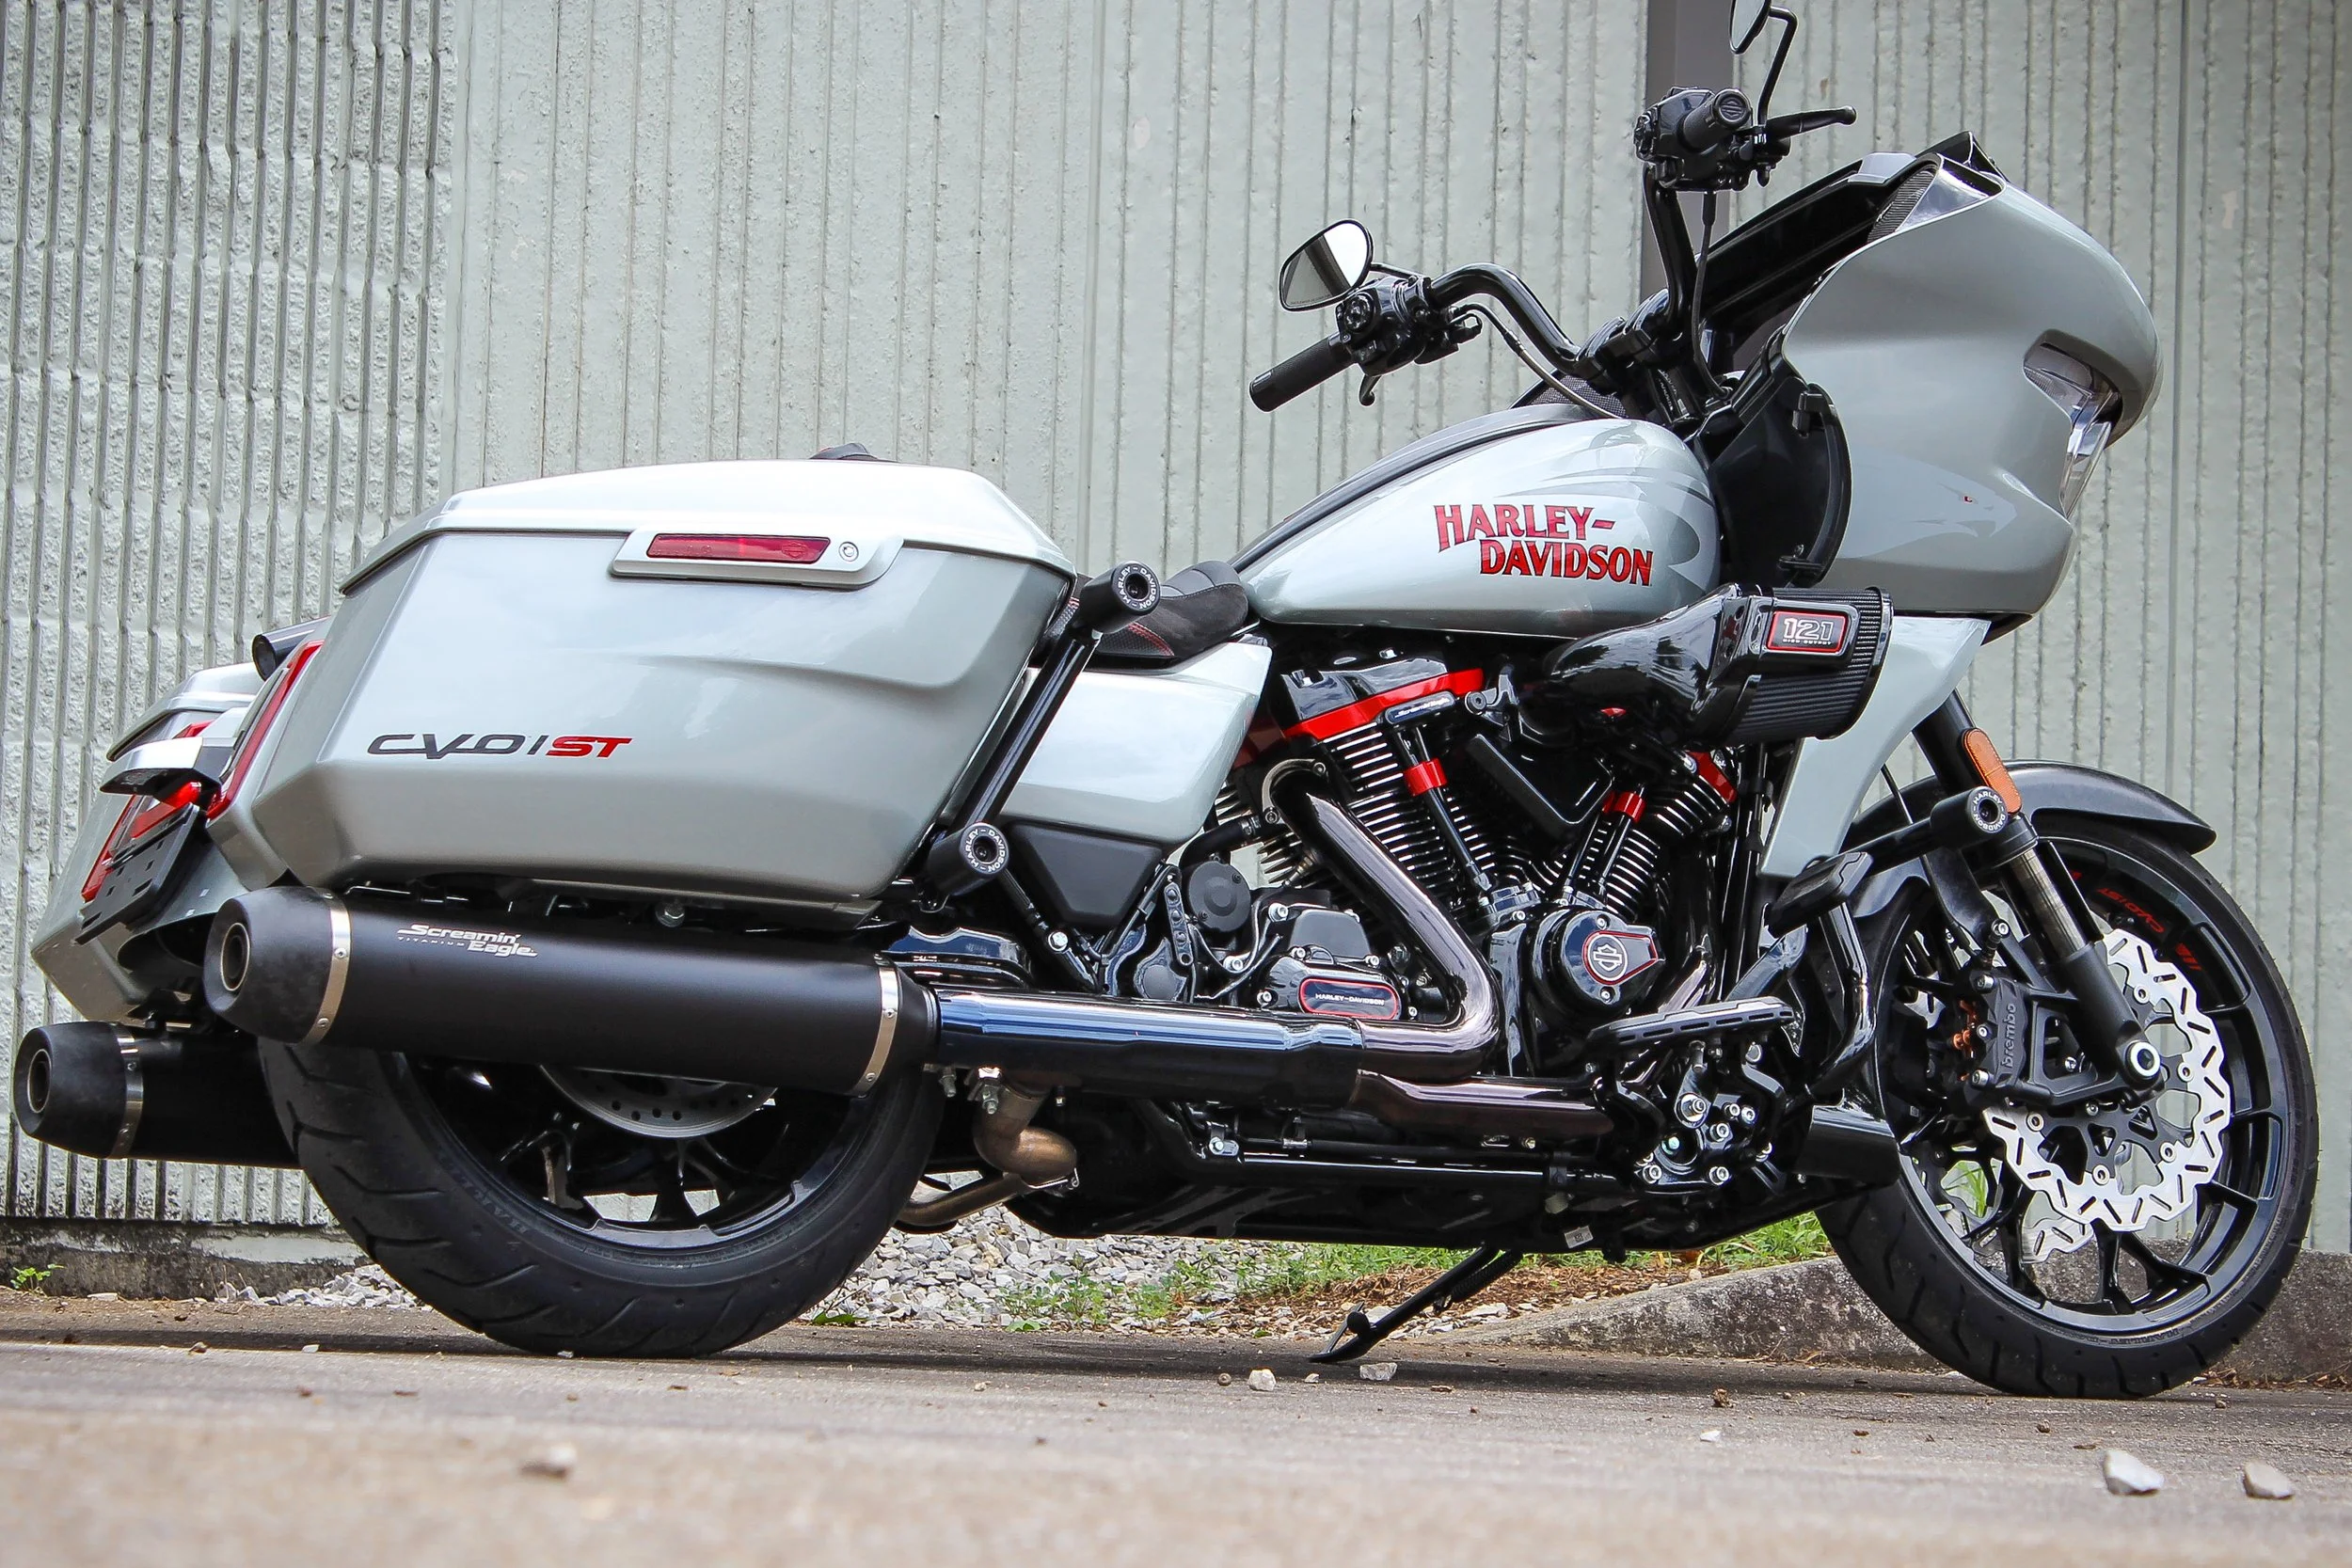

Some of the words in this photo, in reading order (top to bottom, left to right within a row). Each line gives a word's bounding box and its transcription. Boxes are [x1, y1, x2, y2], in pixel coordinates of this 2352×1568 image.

[1479, 540, 1653, 586] DAVIDSON
[1783, 618, 1834, 641] 121
[397, 937, 465, 946] TITANIUM
[1314, 993, 1385, 1006] HARLEY-DAVIDSON
[2001, 1003, 2016, 1069] brembo
